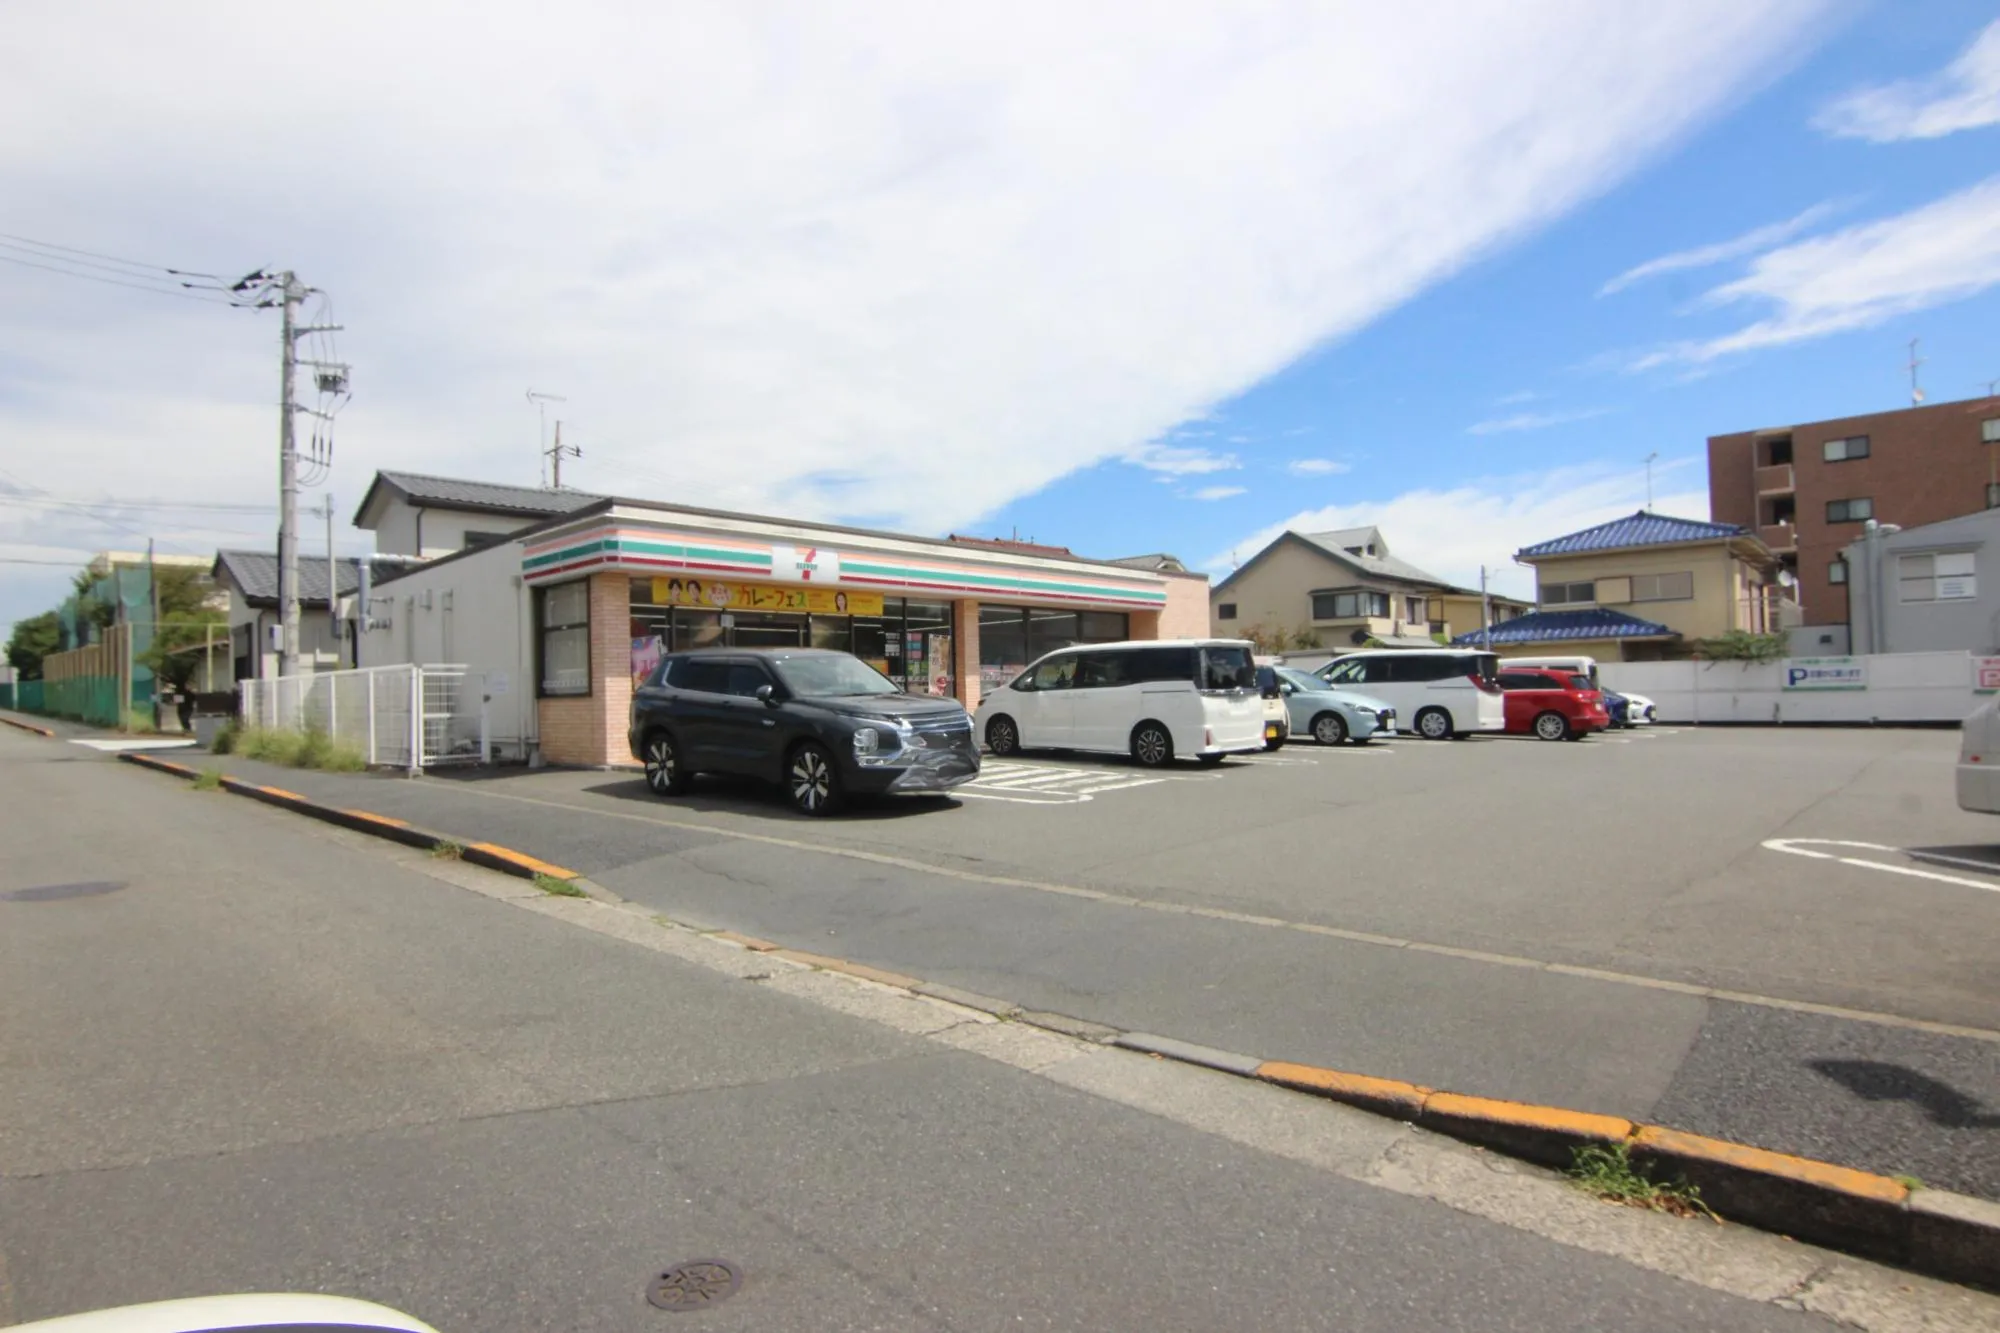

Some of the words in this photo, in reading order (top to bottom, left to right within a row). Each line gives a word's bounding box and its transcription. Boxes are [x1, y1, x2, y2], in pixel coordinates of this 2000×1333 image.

[796, 547, 817, 581] 7
[736, 584, 808, 608] カレーフェス
[1788, 668, 1808, 687] P
